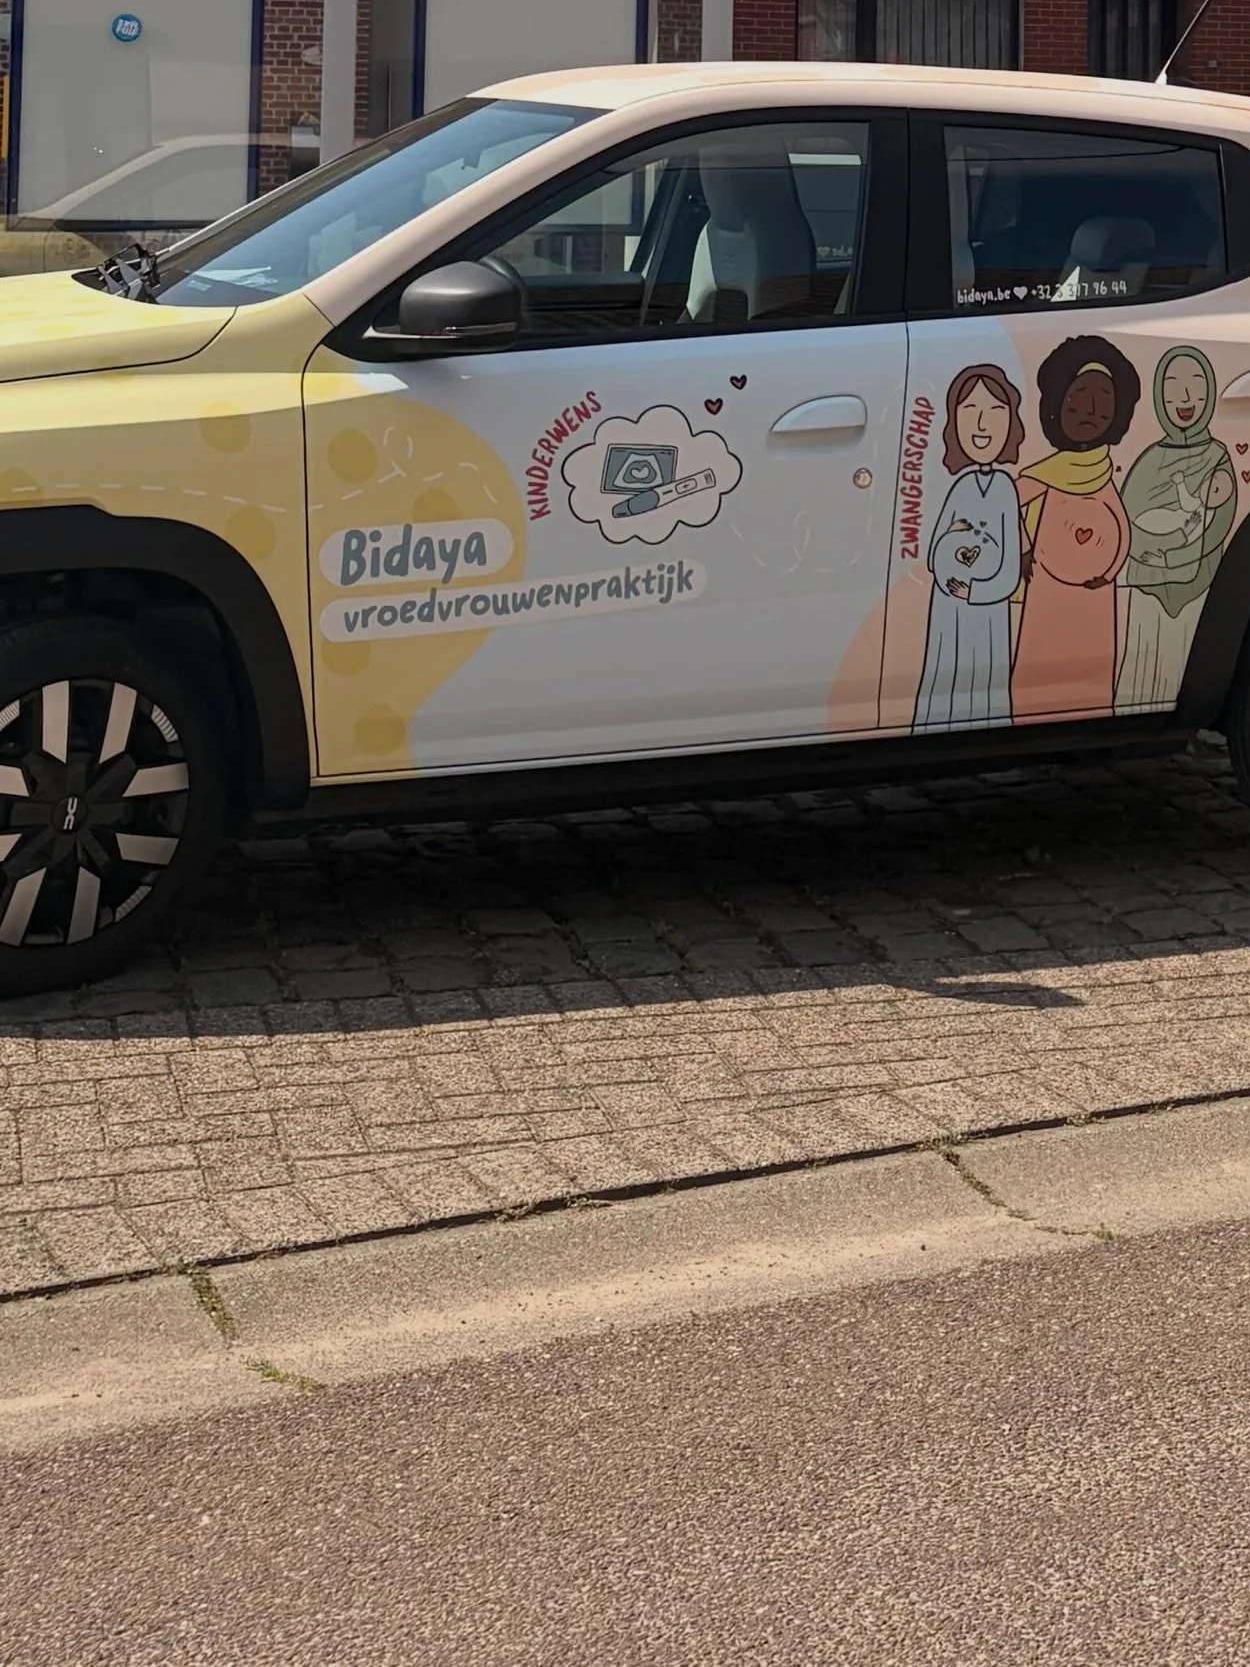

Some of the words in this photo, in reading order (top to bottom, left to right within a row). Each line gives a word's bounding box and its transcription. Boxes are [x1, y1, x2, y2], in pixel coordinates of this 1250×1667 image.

[956, 287, 1010, 305] bidaya.be
[1092, 280, 1107, 295] 96
[1111, 280, 1127, 294] 44
[525, 391, 602, 521] KINDERWENS
[900, 396, 936, 559] ZWANGERSCHAP
[340, 523, 487, 585] Bidaya
[343, 560, 694, 633] vroedvrouwenpraktijk
